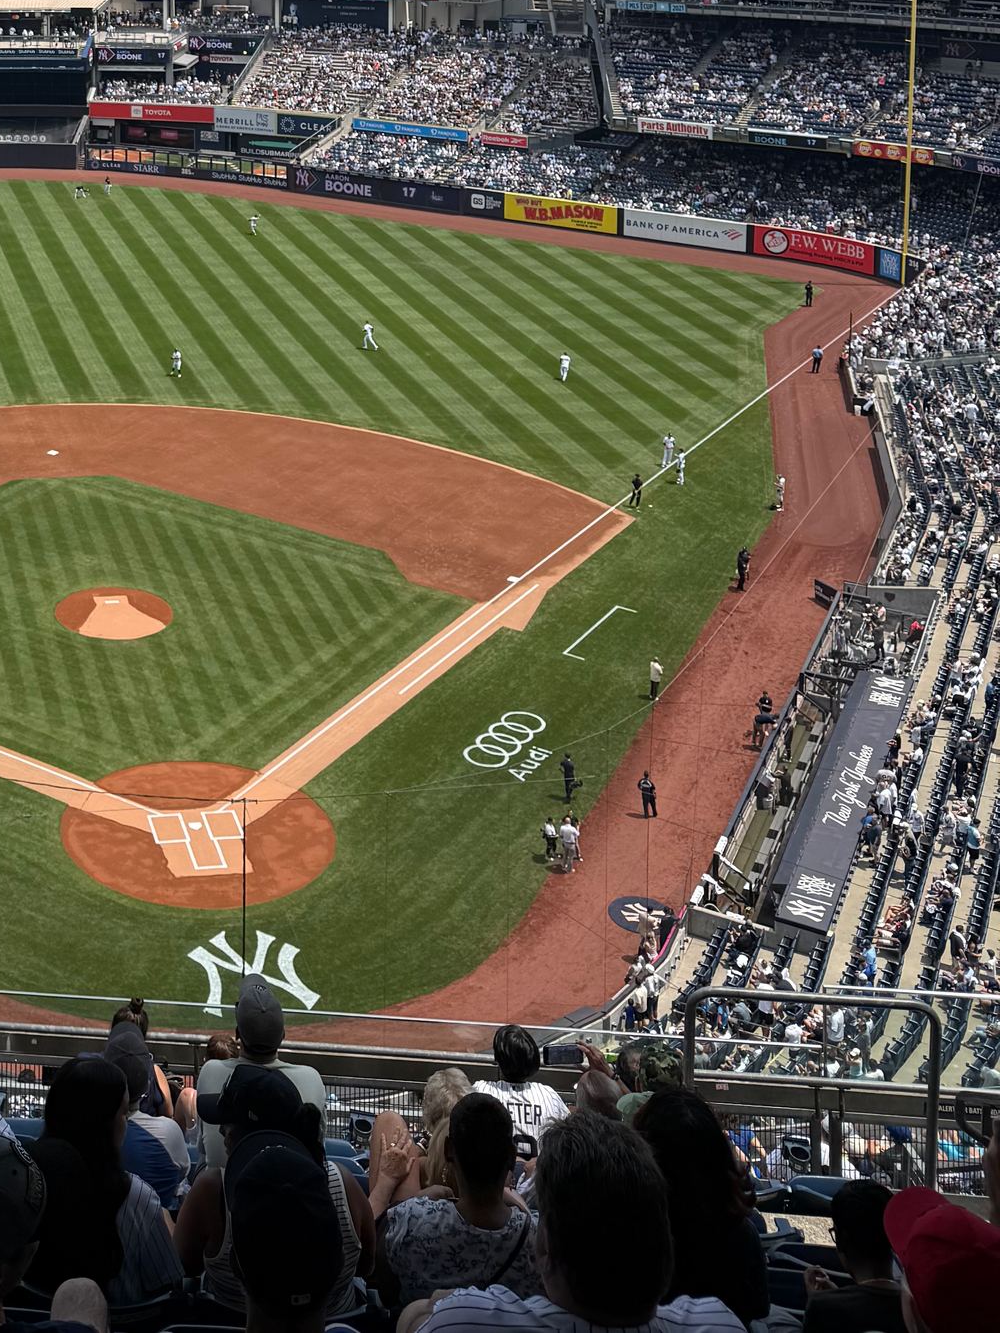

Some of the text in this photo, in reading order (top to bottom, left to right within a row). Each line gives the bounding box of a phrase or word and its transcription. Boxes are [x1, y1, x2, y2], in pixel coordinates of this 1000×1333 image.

[116, 53, 142, 61] BOONE
[216, 117, 254, 126] MERRILL
[300, 122, 332, 132] CLEAR
[641, 121, 709, 136] Parts Authority
[755, 136, 787, 146] BOONE
[134, 164, 160, 174] STARR
[212, 172, 287, 187] StubHub StubHub StubHub
[325, 174, 350, 182] AARON
[325, 180, 372, 197] BOONE
[402, 186, 416, 198] 17
[626, 219, 719, 238] BANK OF AMERICA
[791, 233, 817, 250] F.W.
[821, 238, 865, 259] WEBB
[508, 746, 553, 782] Audi
[822, 745, 876, 827] New York Yankees
[187, 930, 321, 1017] NY
[507, 1103, 542, 1126] ETER
